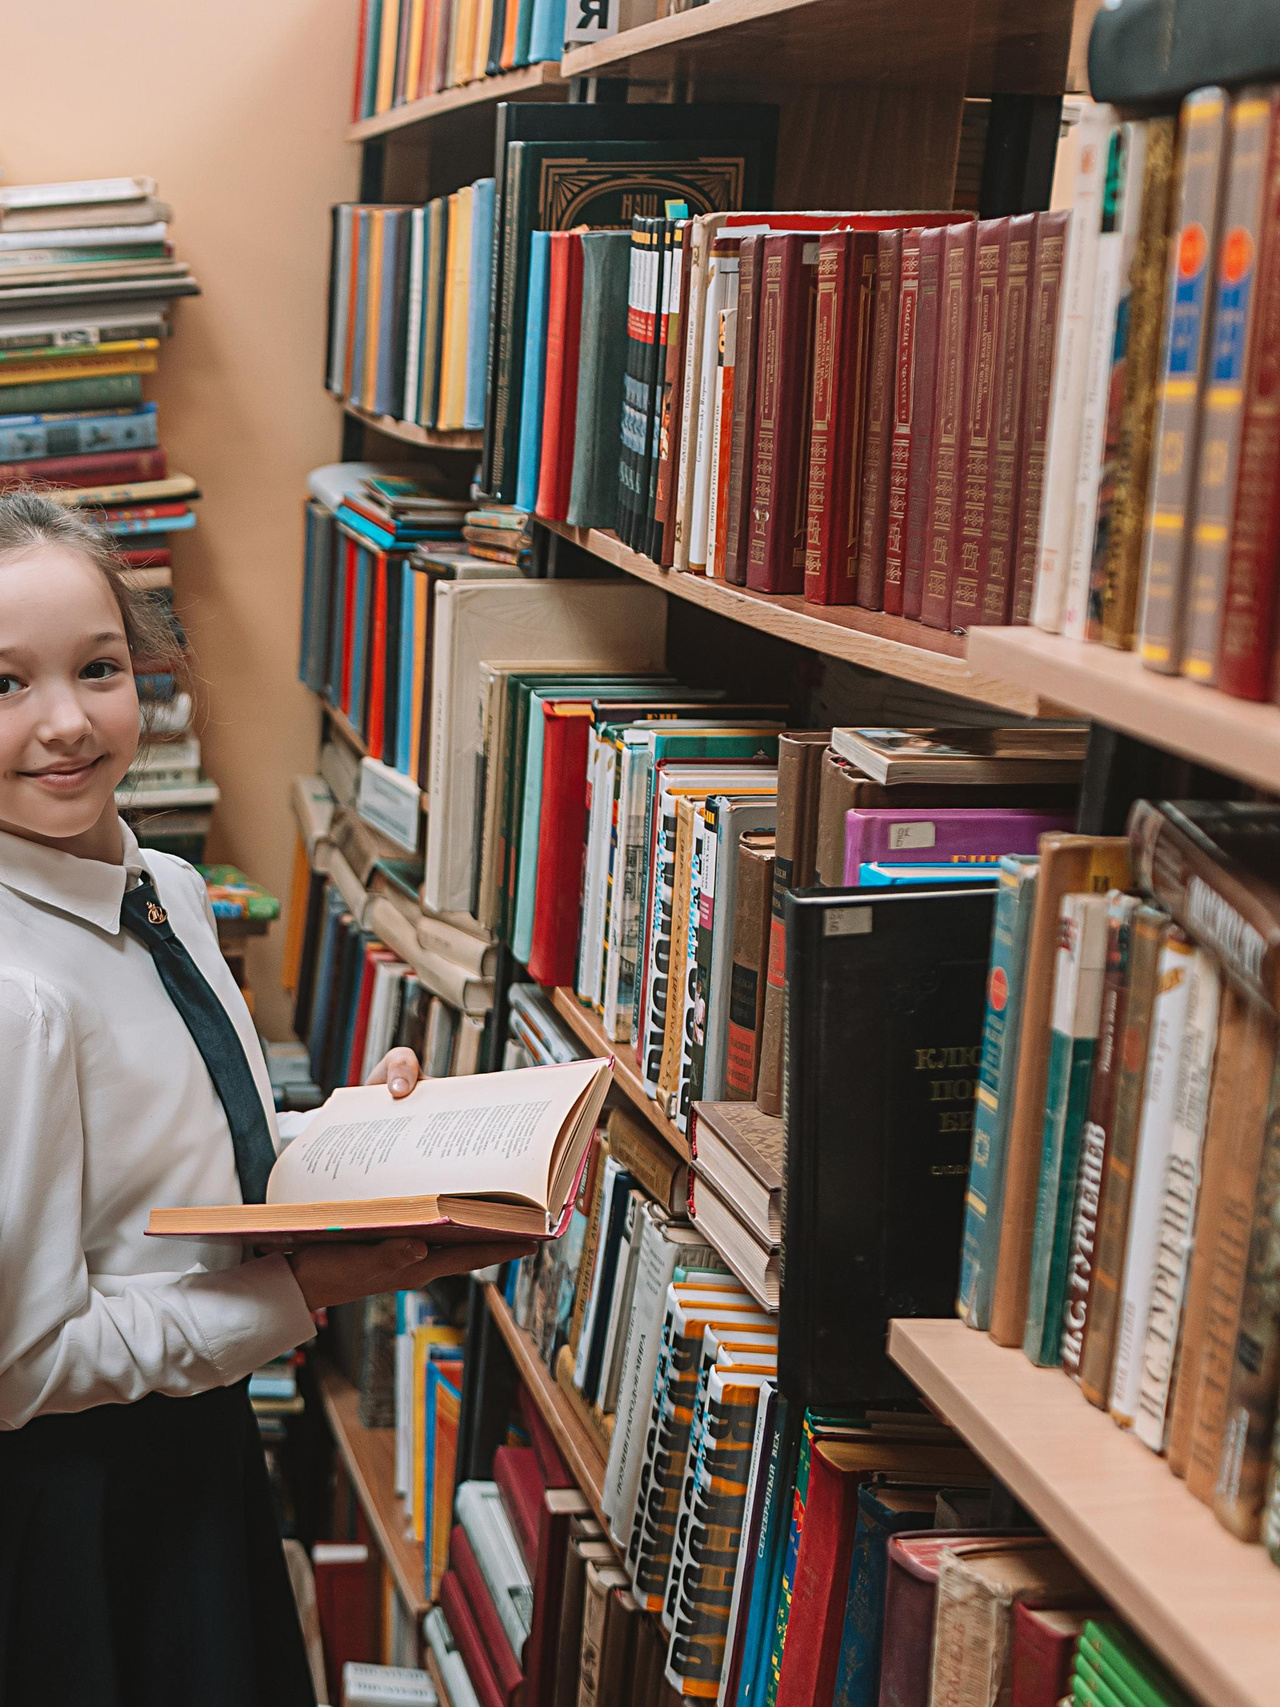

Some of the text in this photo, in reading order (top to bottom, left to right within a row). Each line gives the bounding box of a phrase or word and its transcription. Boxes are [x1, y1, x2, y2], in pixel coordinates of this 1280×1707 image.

[902, 295, 913, 346] ПЕТРОВ
[902, 350, 908, 361] Е.
[931, 1079, 978, 1101] ПО
[1068, 1122, 1110, 1293] ТУРГЕНЕВ
[1142, 1152, 1199, 1346] ТУРГЕНЕВ
[635, 1333, 648, 1371] МИРА
[757, 1430, 781, 1558] СЕРЕБРЯНЫЙ ВЕК
[669, 1398, 754, 1682] РУССКАЯ
